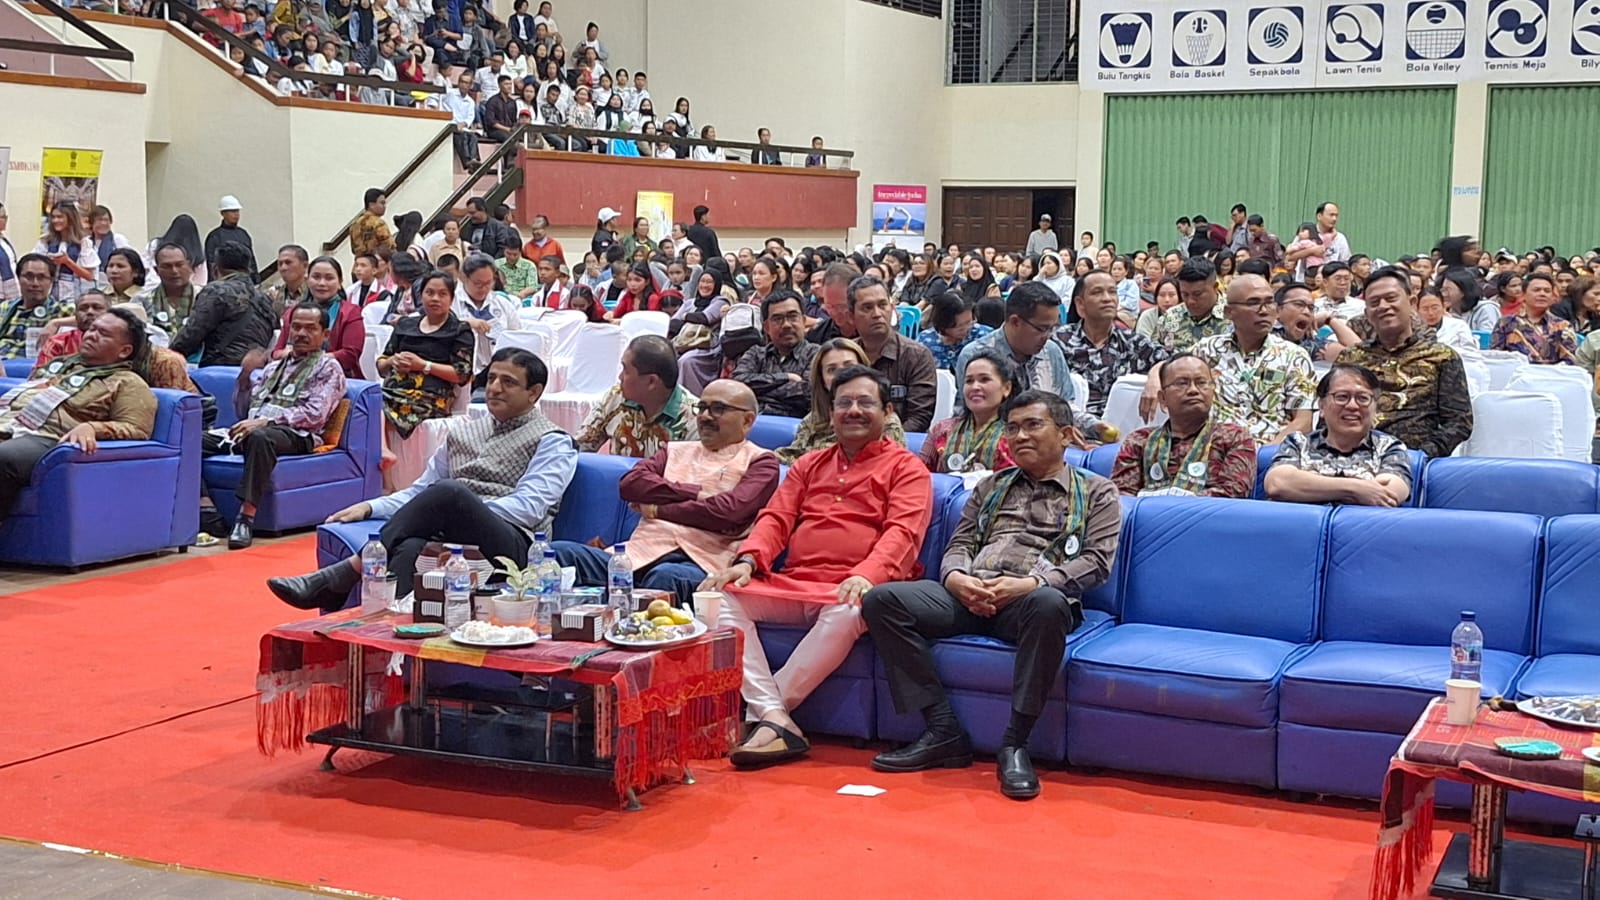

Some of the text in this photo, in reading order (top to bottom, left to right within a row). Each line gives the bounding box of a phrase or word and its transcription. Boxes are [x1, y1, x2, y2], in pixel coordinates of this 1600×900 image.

[1325, 64, 1382, 75] Lawn Tenis
[1406, 62, 1461, 73] Bola Volley
[1485, 60, 1546, 71] Tennis Meja
[1119, 71, 1151, 82] Tangkis
[1169, 70, 1225, 79] Bola Basket
[1249, 67, 1300, 78] Sepakbola
